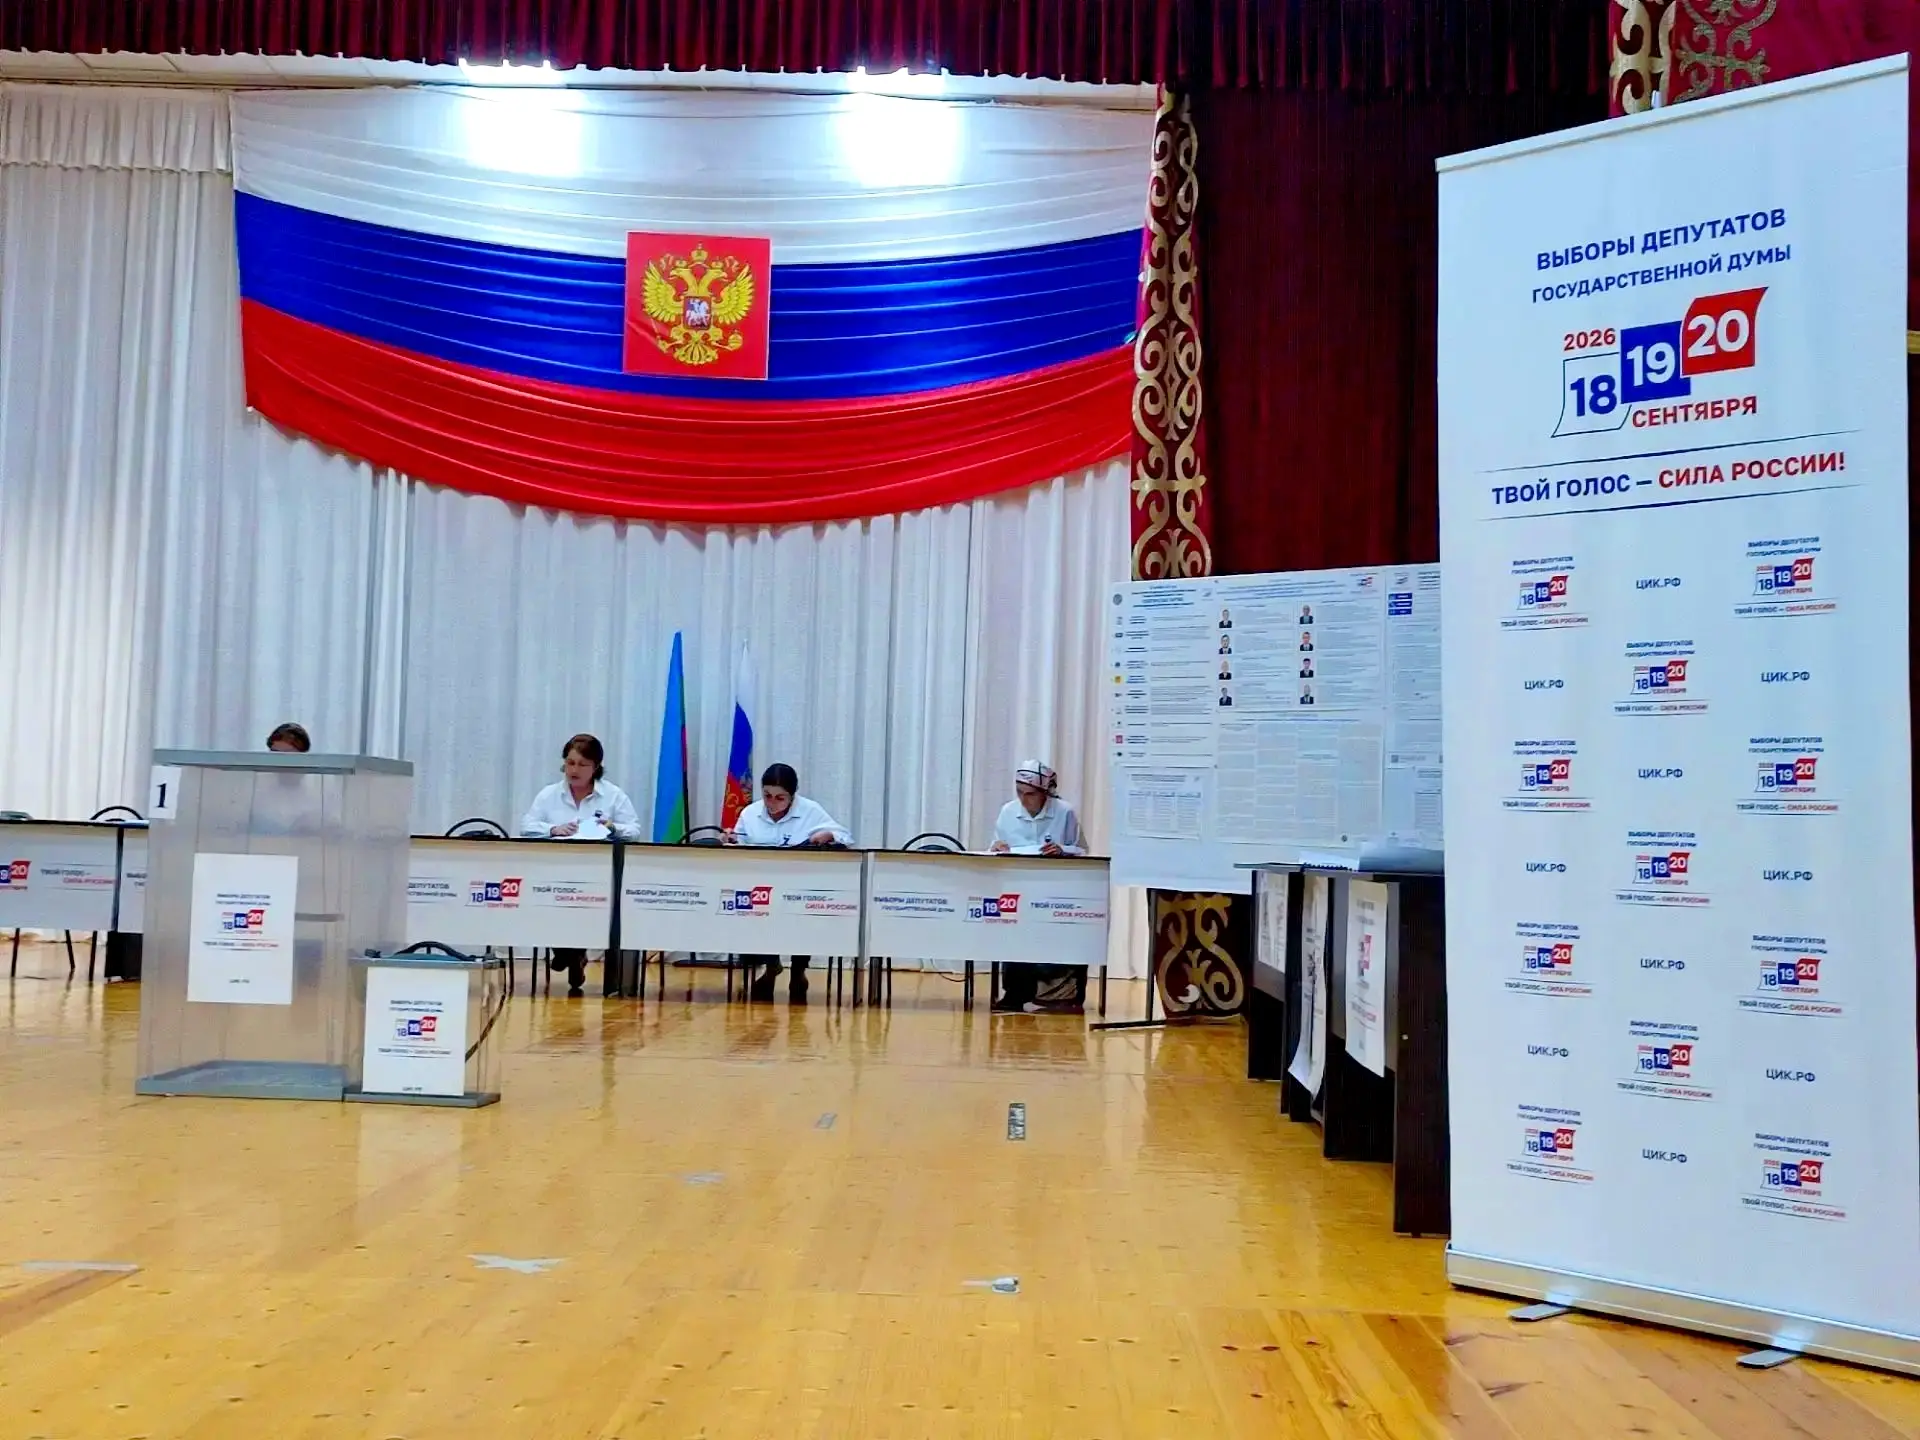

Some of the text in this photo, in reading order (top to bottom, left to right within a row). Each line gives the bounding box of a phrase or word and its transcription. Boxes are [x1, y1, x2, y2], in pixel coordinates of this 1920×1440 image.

[1536, 208, 1787, 271] ВЫБОРЫ ДЕПУТАТОВ
[1532, 245, 1791, 303] ГОСУДАРСТВЕННОЙ ДУМЫ
[1563, 328, 1616, 351] 2026
[1687, 309, 1750, 359] 20
[1626, 342, 1676, 387] 19
[1569, 374, 1618, 417] 18
[1631, 396, 1758, 428] СЕНТЯБРЯ
[1491, 478, 1551, 505] ТВОЙ
[1556, 474, 1631, 499] ГОЛОС
[1658, 464, 1725, 489] СИЛА
[1731, 452, 1846, 481] РОССИИ!
[1793, 563, 1810, 577] 20
[1635, 577, 1681, 590] ЦИК.РФ
[1776, 571, 1791, 584] 19
[1550, 580, 1565, 592] 20
[1759, 578, 1773, 590] 18
[1537, 587, 1549, 599] 19
[1521, 594, 1535, 605] 18
[1651, 671, 1665, 683] 19
[1667, 665, 1684, 678] 20
[1761, 671, 1811, 683] ЦИК.РФ
[1524, 678, 1565, 690] ЦИК.РФ
[1636, 678, 1649, 690] 18
[1552, 763, 1567, 775] 20
[1638, 768, 1683, 780] ЦИК.РФ
[1796, 762, 1813, 775] 20
[1524, 775, 1535, 787] 18
[1538, 769, 1550, 781] 19
[1777, 769, 1793, 781] 19
[1760, 776, 1775, 788] 18
[155, 782, 168, 809] 1
[1526, 862, 1567, 874] ЦИК.РФ
[1653, 861, 1667, 874] 19
[1670, 856, 1686, 869] 20
[11, 865, 28, 877] 20
[1638, 868, 1651, 879] 18
[1763, 870, 1813, 882] ЦИК.РФ
[487, 887, 500, 898] 19
[502, 882, 518, 894] 20
[472, 892, 484, 903] 18
[738, 895, 750, 906] 19
[753, 890, 768, 901] 20
[722, 900, 734, 911] 18
[985, 902, 997, 914] 19
[1000, 898, 1016, 909] 20
[970, 908, 982, 919] 18
[1539, 952, 1551, 964] 19
[1554, 948, 1570, 960] 20
[1526, 957, 1537, 969] 18
[1640, 958, 1686, 971] ЦИК.РФ
[1779, 967, 1795, 981] 19
[1798, 963, 1816, 976] 20
[1763, 974, 1777, 986] 18
[1527, 1045, 1570, 1058] ЦИК.РФ
[1671, 1048, 1688, 1062] 20
[1640, 1058, 1653, 1070] 18
[1655, 1052, 1669, 1066] 19
[1766, 1069, 1816, 1083] ЦИК.РФ
[1541, 1135, 1554, 1148] 19
[1557, 1132, 1572, 1145] 20
[1528, 1141, 1539, 1153] 18
[1642, 1149, 1688, 1164] ЦИК.РФ
[1782, 1167, 1798, 1182] 19
[1800, 1164, 1819, 1179] 20
[1766, 1172, 1780, 1185] 18
